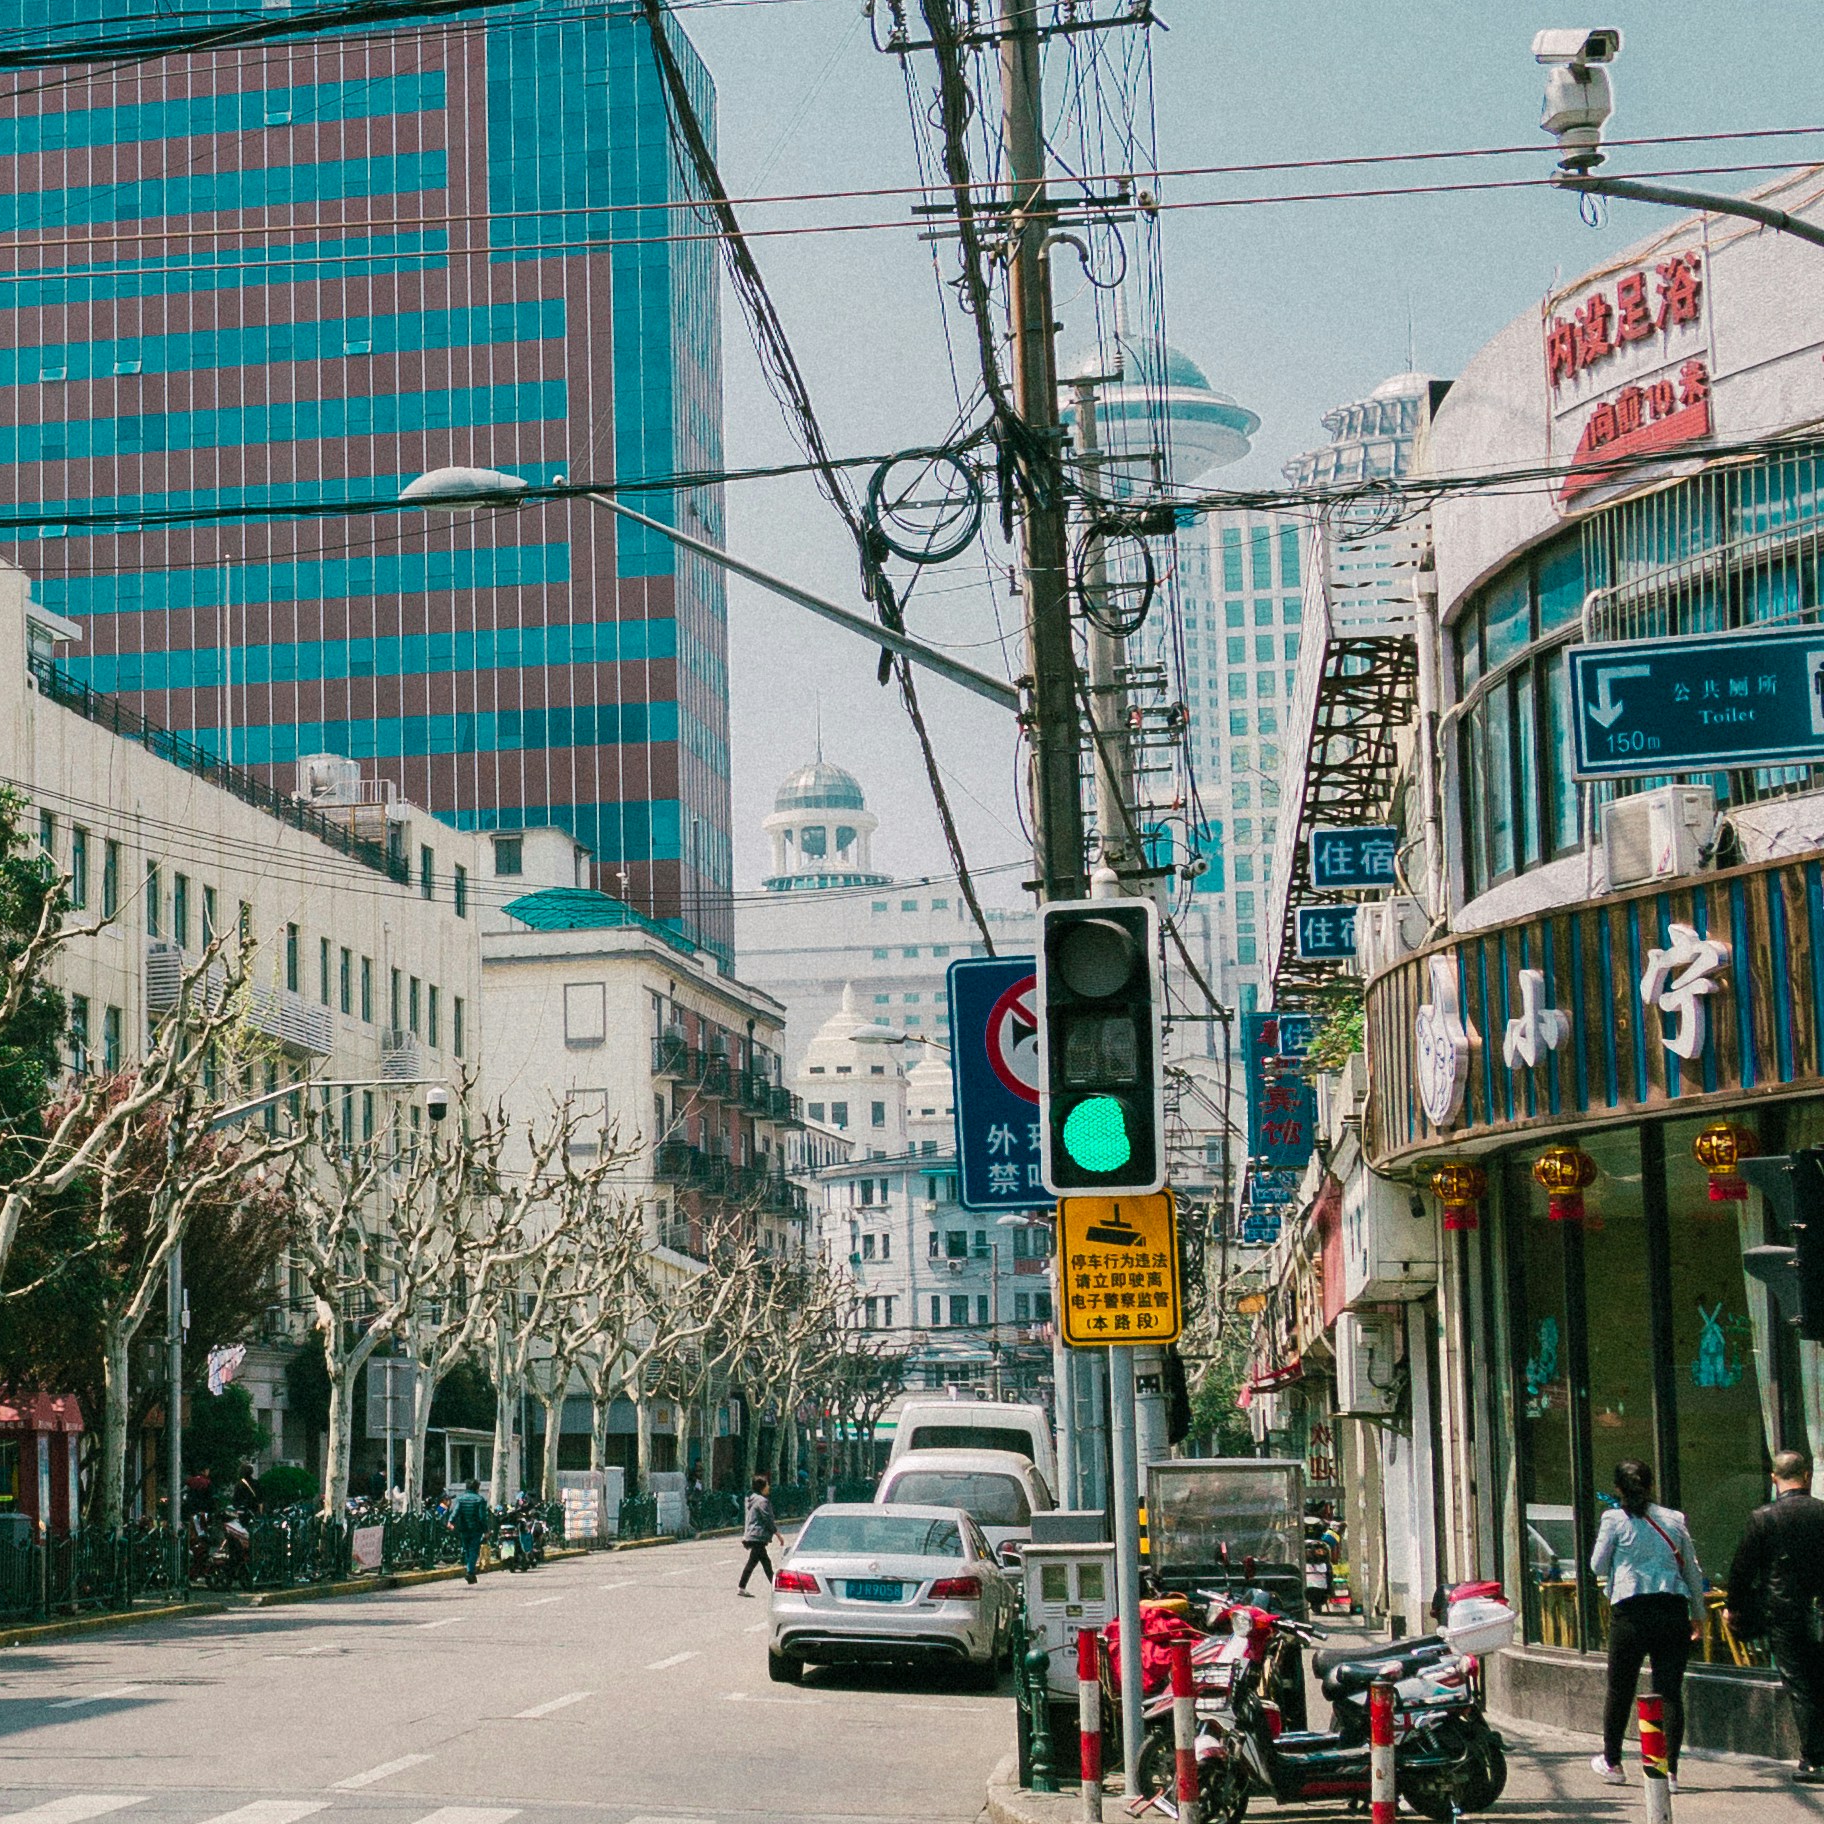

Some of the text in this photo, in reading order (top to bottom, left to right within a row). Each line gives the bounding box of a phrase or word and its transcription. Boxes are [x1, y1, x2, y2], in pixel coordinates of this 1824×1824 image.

[1547, 251, 1703, 388] 内设足浴
[1674, 674, 1777, 702] 公共厕所
[1698, 708, 1757, 725] Toilet
[1606, 730, 1661, 754] 150m
[1319, 838, 1395, 877] 住宿
[1070, 1253, 1169, 1271] 停车行为违法
[1074, 1271, 1163, 1290] 请立即驶离
[1071, 1291, 1169, 1310] 电子警察监管
[1086, 1312, 1159, 1333] (本路段)
